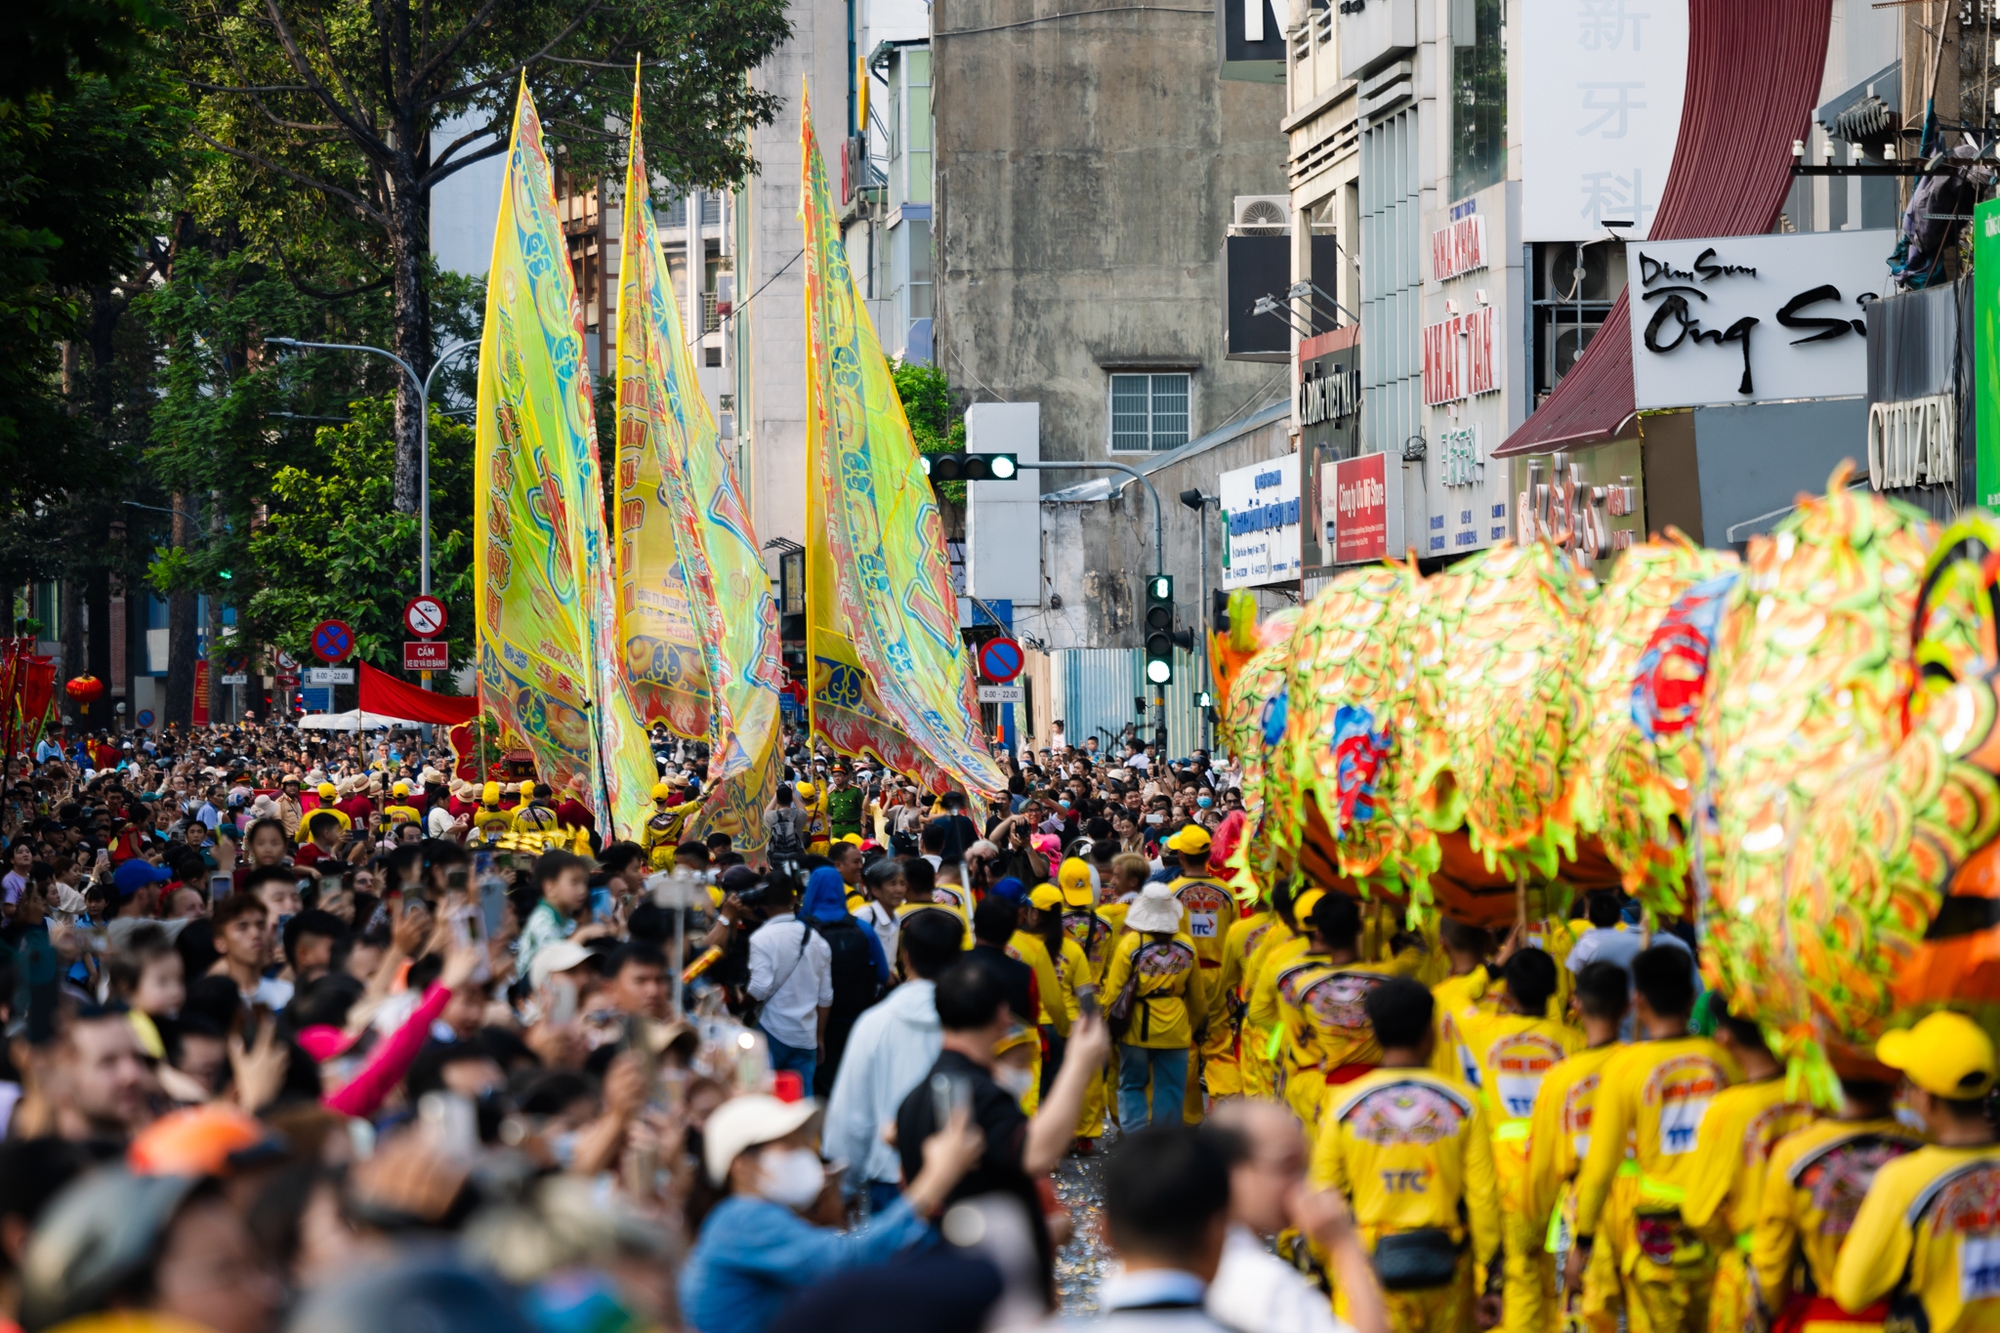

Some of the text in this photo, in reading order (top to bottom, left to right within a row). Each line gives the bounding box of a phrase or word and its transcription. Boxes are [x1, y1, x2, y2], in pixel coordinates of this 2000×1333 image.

[1575, 0, 1653, 230] 新牙科
[1433, 216, 1481, 281] NHA KHOA
[1639, 248, 1757, 287] Dim Sum
[1642, 286, 1760, 394] Ông
[1371, 477, 1384, 507] Store
[406, 659, 413, 667] XE
[432, 657, 446, 667] BÁNH
[417, 645, 435, 657] CẤM
[984, 689, 996, 698] 6:00
[1002, 689, 1019, 698] 22:00
[1192, 924, 1210, 935] TTC
[1382, 1169, 1427, 1194] TTC
